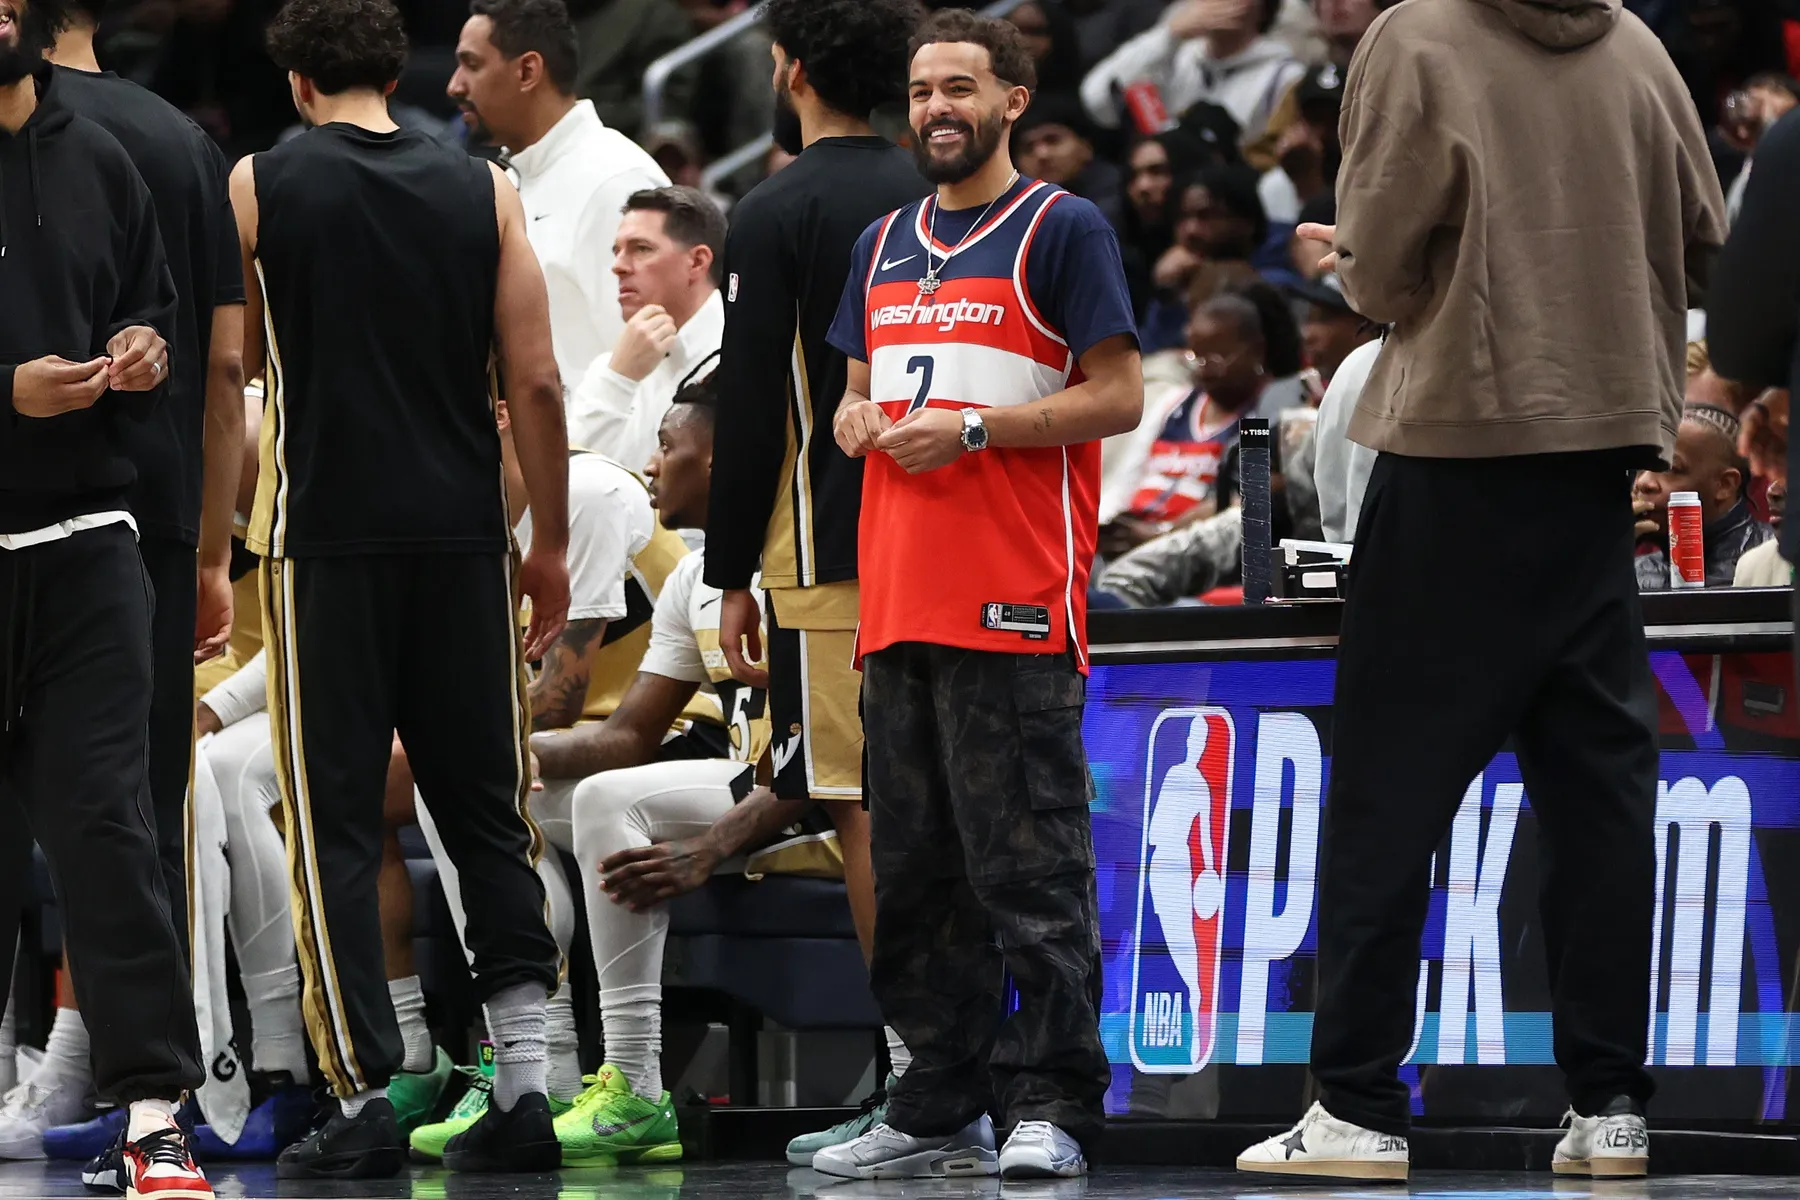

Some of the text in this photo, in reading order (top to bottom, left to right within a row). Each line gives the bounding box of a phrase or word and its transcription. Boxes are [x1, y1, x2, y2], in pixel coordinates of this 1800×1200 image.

[870, 293, 1005, 332] washington
[905, 354, 935, 416] 2
[730, 687, 751, 762] 5
[1142, 991, 1182, 1047] NBA
[211, 1051, 237, 1082] G
